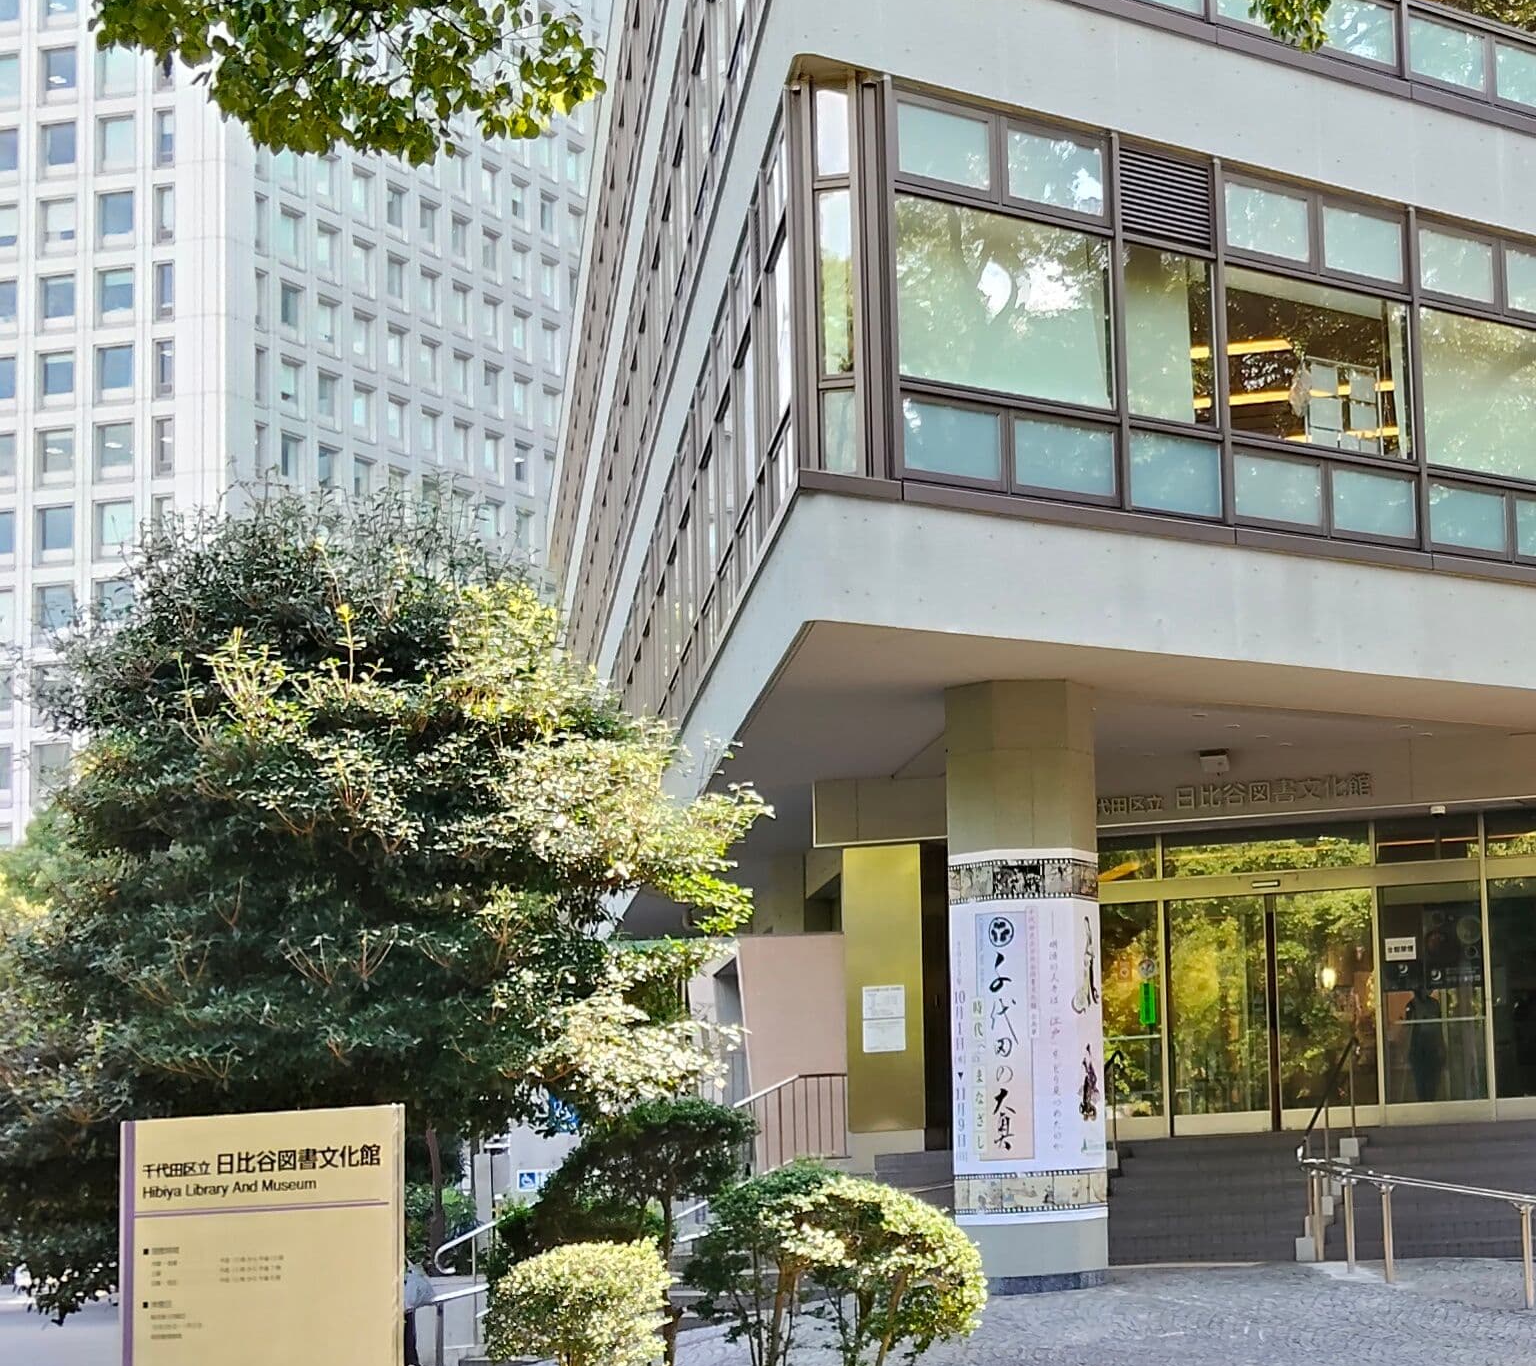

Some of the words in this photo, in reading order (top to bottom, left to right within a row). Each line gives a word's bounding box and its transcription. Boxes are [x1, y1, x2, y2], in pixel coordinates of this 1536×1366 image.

[1096, 795, 1164, 816] 代田区立
[1175, 772, 1375, 811] 日比谷図書文化館
[142, 1160, 212, 1179] 千代田区立
[216, 1143, 382, 1176] 日比谷図書文化館
[142, 1185, 182, 1201] Hibiya
[185, 1183, 230, 1197] Library
[232, 1180, 258, 1194] And
[261, 1178, 318, 1192] Museum
